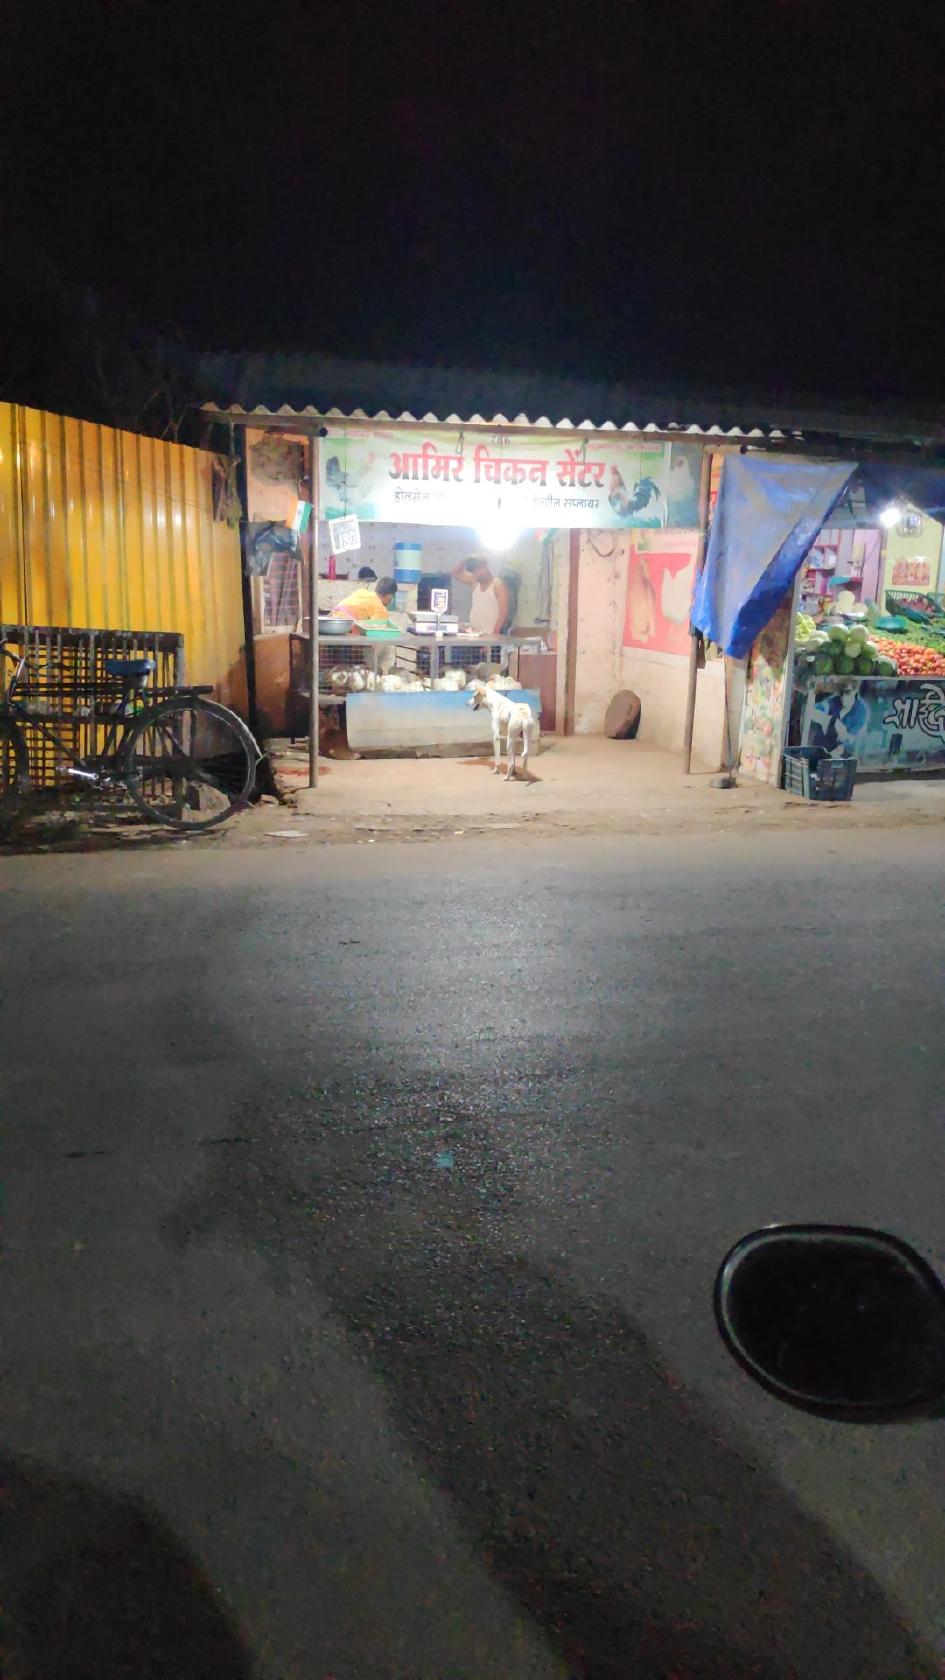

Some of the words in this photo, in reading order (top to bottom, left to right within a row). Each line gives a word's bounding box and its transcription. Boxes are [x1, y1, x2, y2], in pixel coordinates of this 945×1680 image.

[388, 441, 465, 482] आमिर
[473, 443, 549, 487] चिकन
[556, 448, 606, 488] सेंटर
